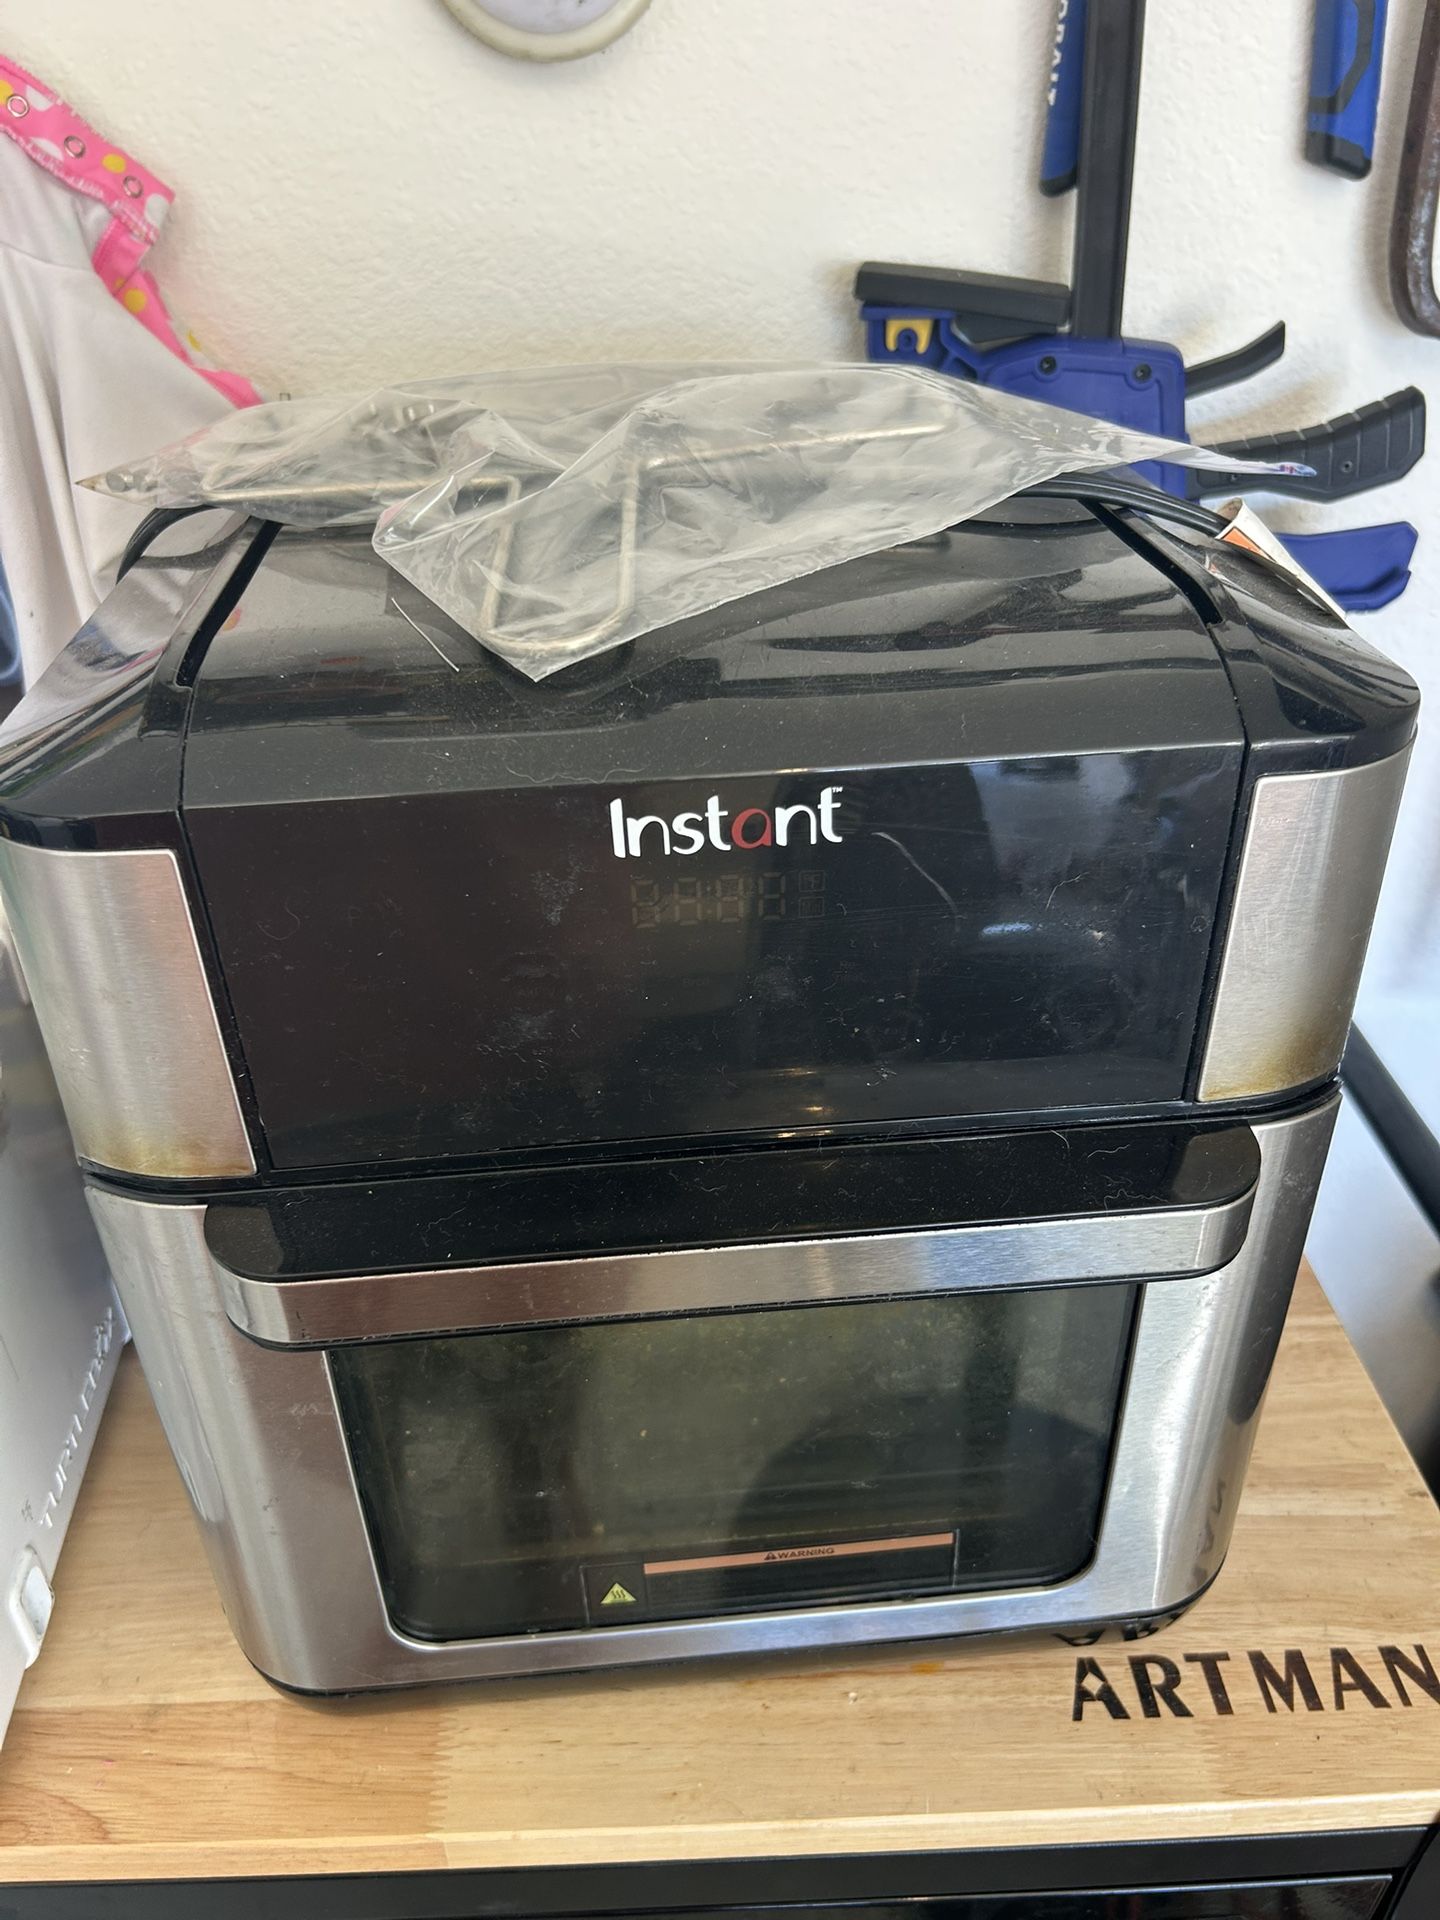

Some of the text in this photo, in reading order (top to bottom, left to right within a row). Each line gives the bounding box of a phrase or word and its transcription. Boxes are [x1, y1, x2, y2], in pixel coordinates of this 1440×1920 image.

[609, 787, 843, 858] Instant
[777, 1546, 836, 1559] WARNING
[1072, 1644, 1440, 1721] ARTMAN
